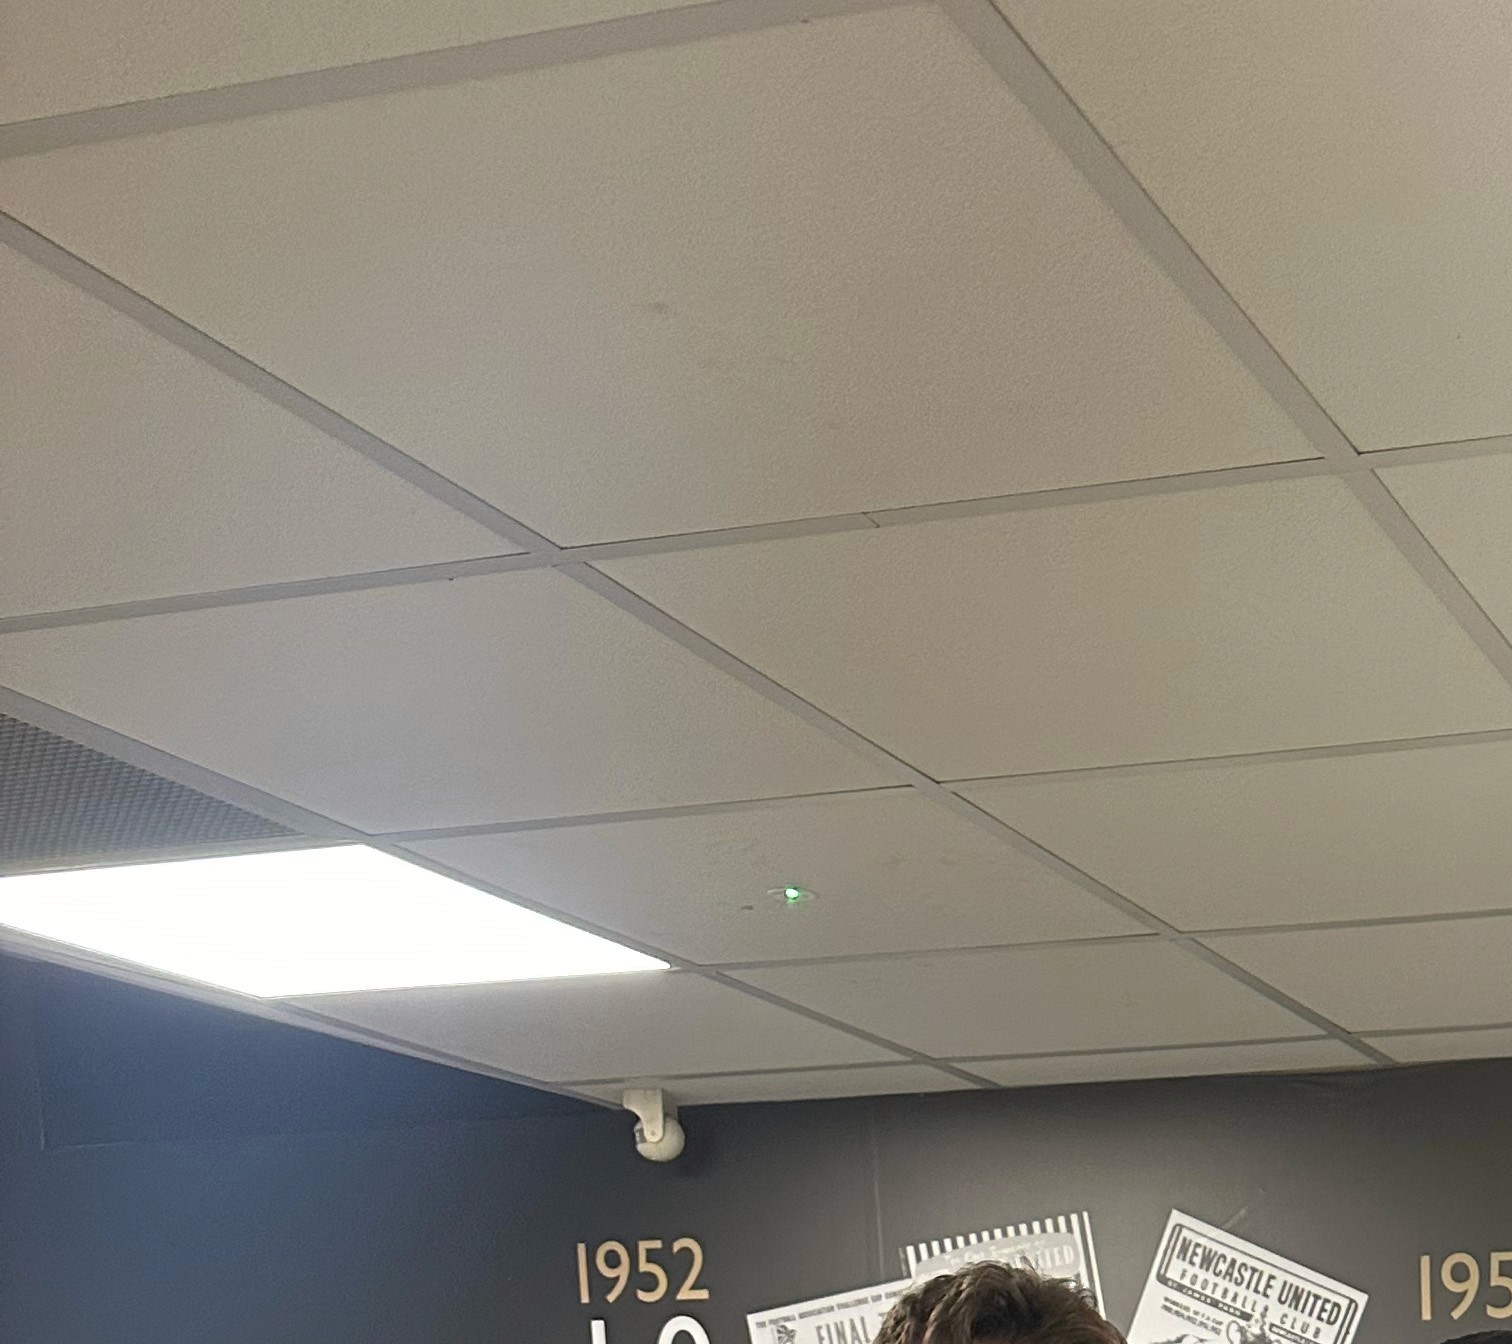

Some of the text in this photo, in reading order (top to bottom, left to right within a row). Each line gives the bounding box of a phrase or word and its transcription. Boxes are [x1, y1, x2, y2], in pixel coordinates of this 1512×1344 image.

[576, 1238, 710, 1303] 1952
[1175, 1236, 1277, 1299] NEWCASTLE
[1278, 1279, 1342, 1326] UNITED
[1179, 1269, 1321, 1339] FOOTBALL CLUB
